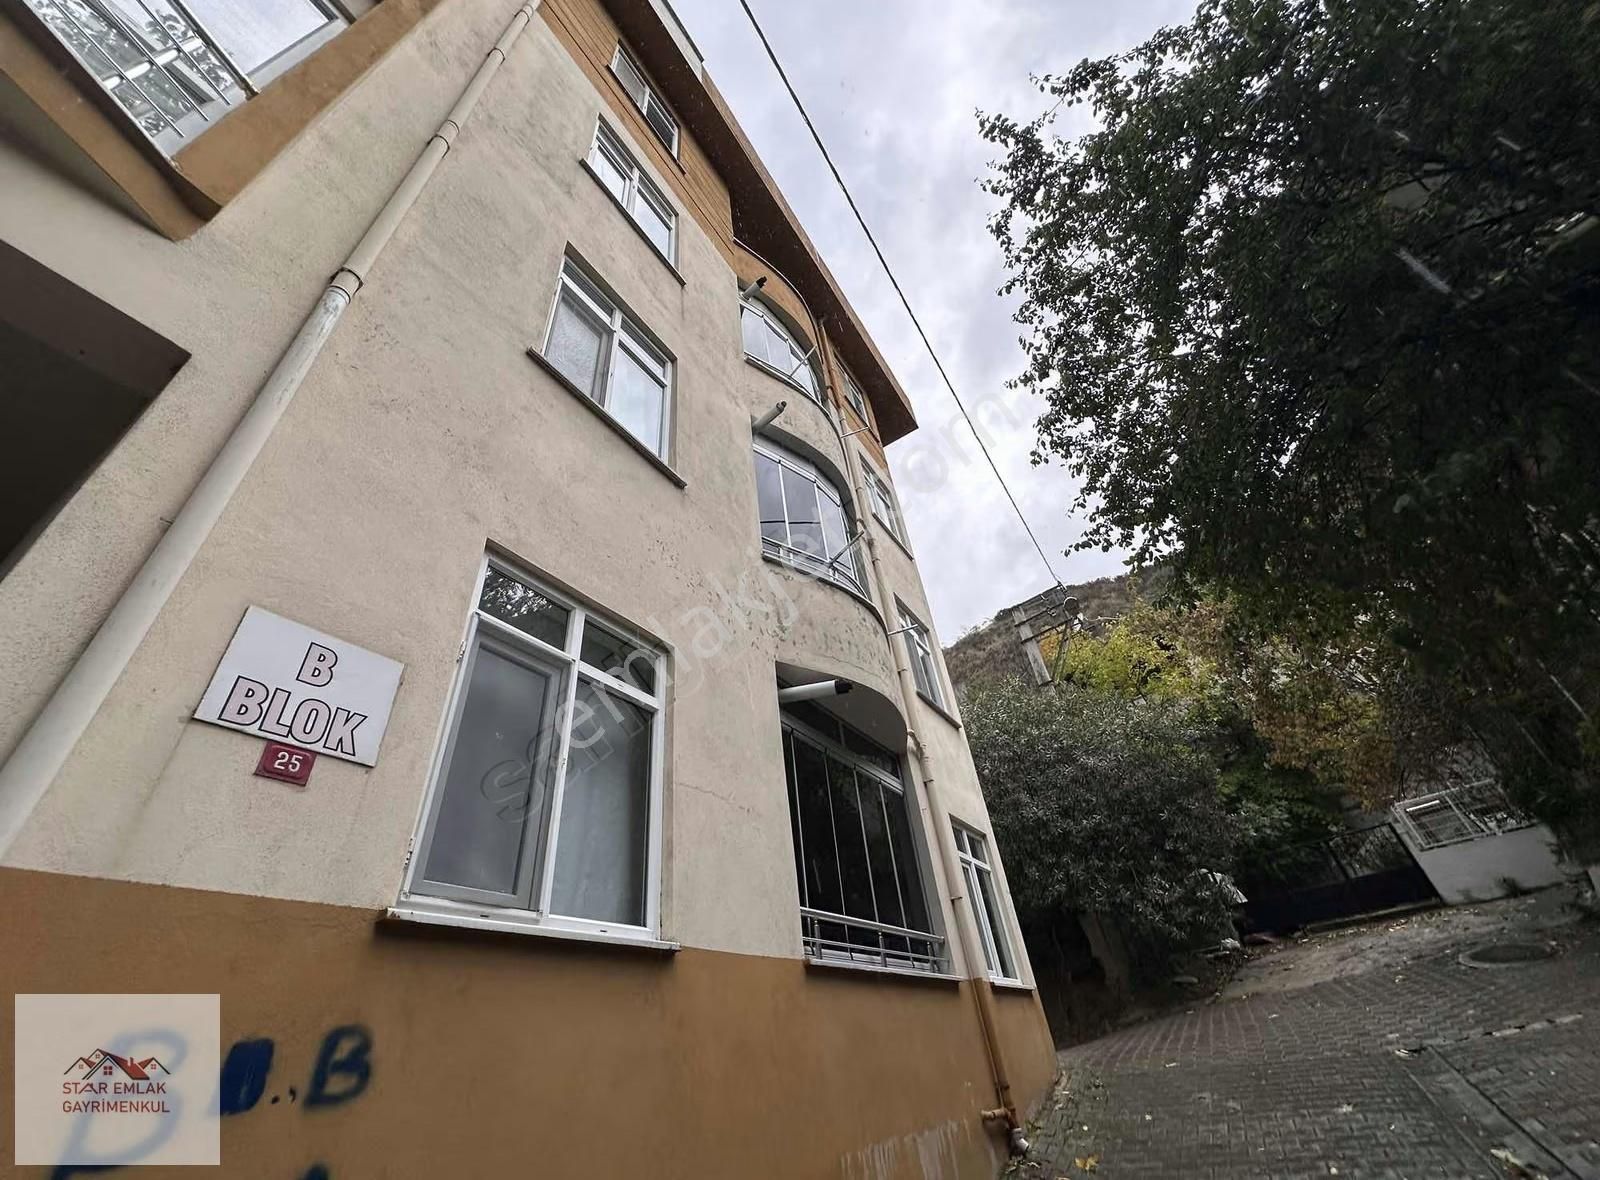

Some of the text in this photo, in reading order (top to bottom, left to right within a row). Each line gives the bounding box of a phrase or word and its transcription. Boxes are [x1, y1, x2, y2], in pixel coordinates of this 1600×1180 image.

[295, 641, 338, 688] B
[217, 674, 368, 757] BLOK
[273, 751, 303, 772] 25
